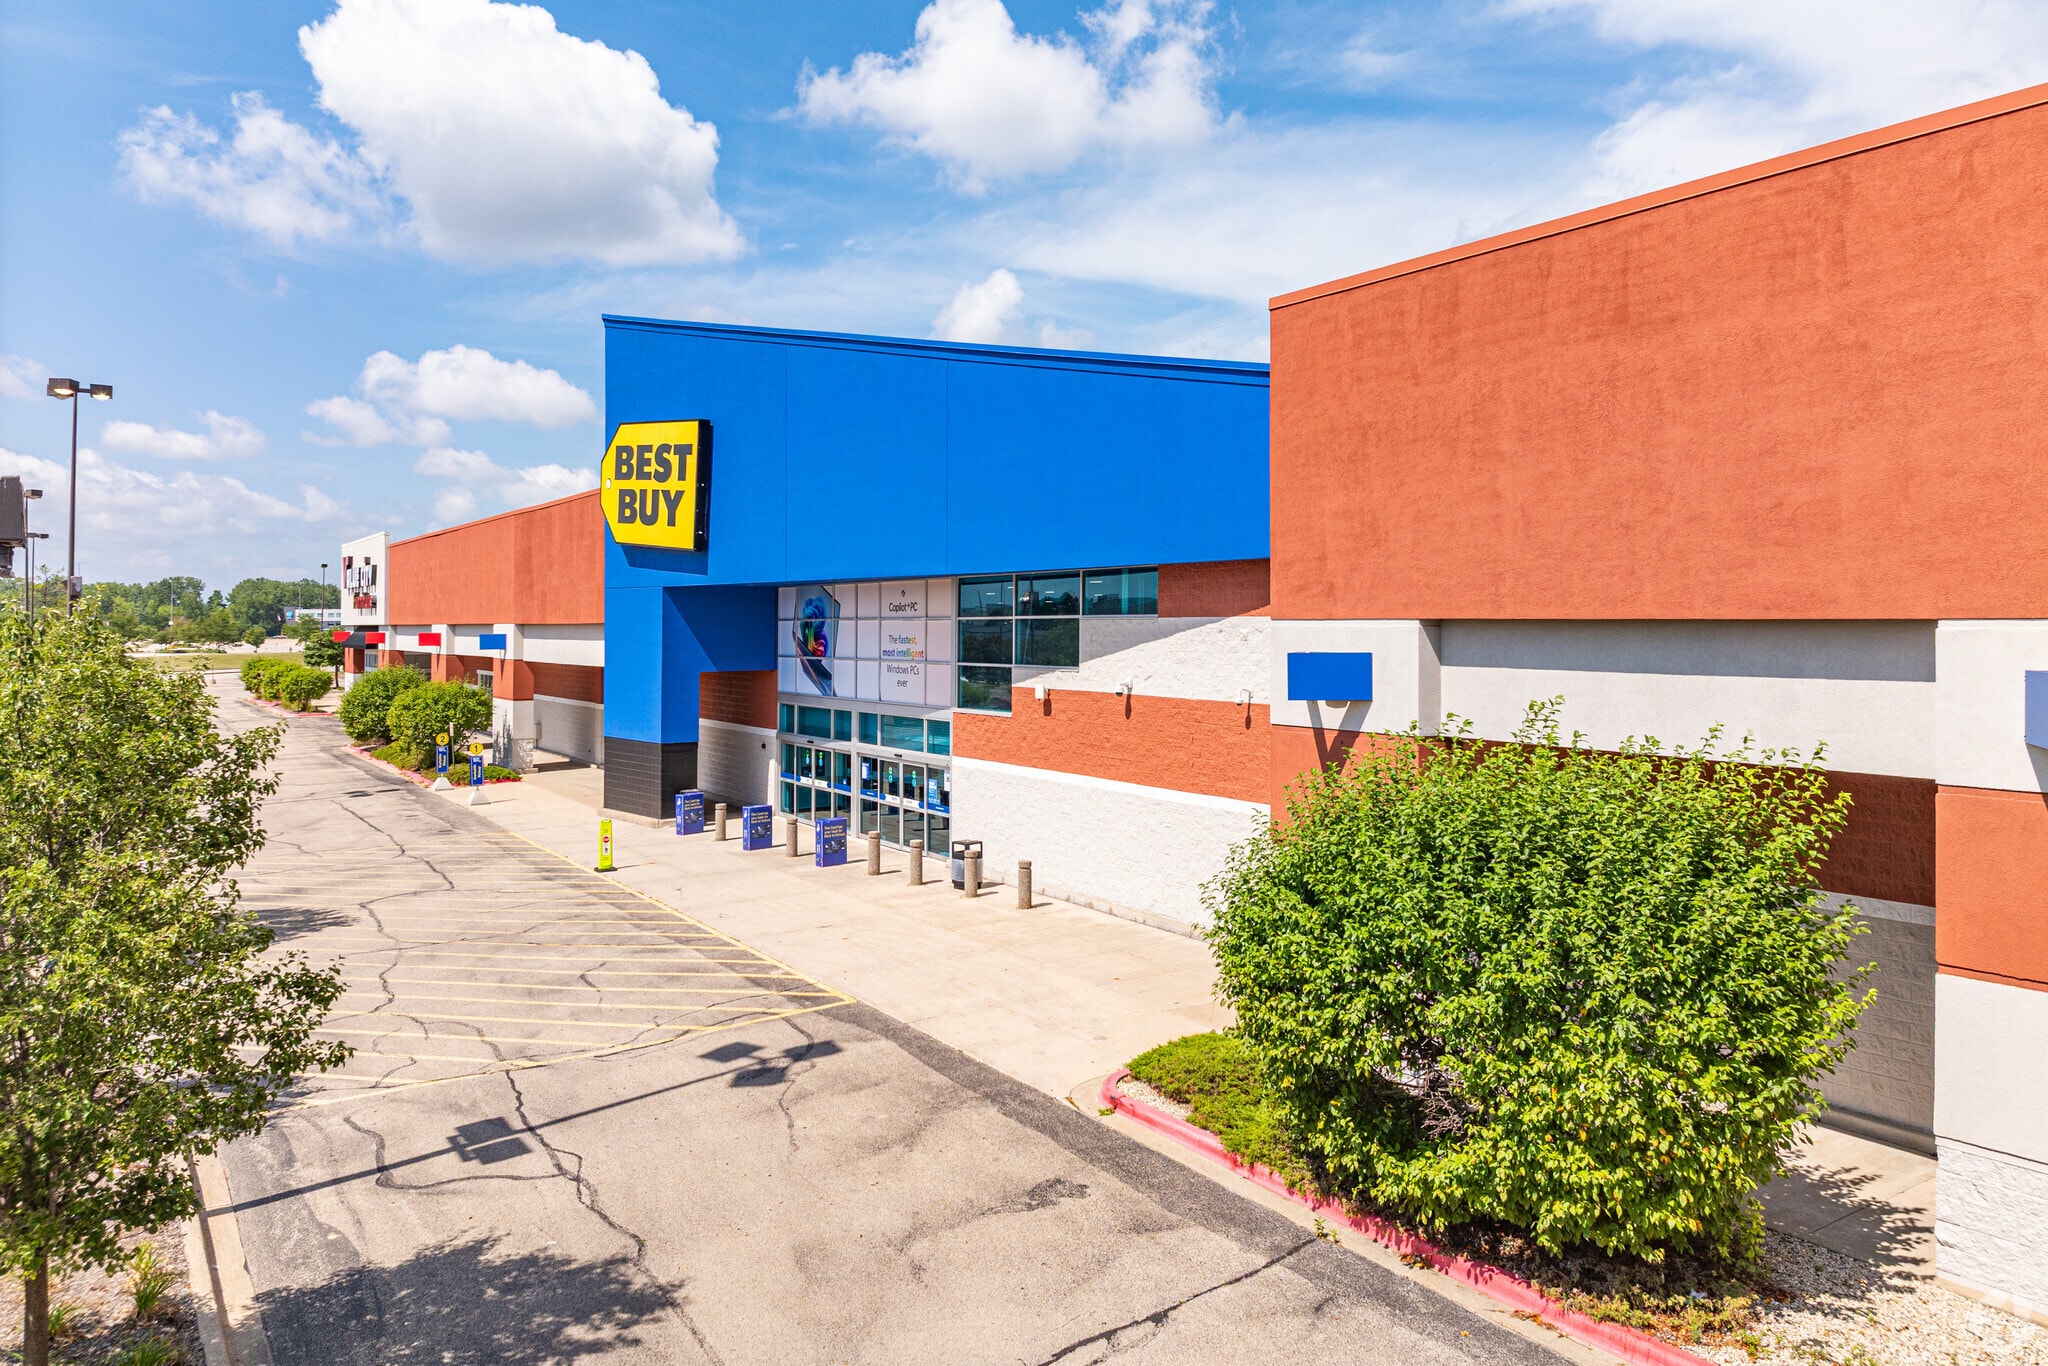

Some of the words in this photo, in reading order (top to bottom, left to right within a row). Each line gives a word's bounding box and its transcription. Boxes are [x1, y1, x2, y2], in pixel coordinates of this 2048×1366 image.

[614, 443, 693, 483] BEST
[618, 489, 686, 527] BUY
[888, 635, 898, 644] The
[898, 635, 918, 645] fastest,
[896, 648, 924, 660] intelligent
[886, 664, 909, 674] Windows
[910, 666, 920, 675] PCs
